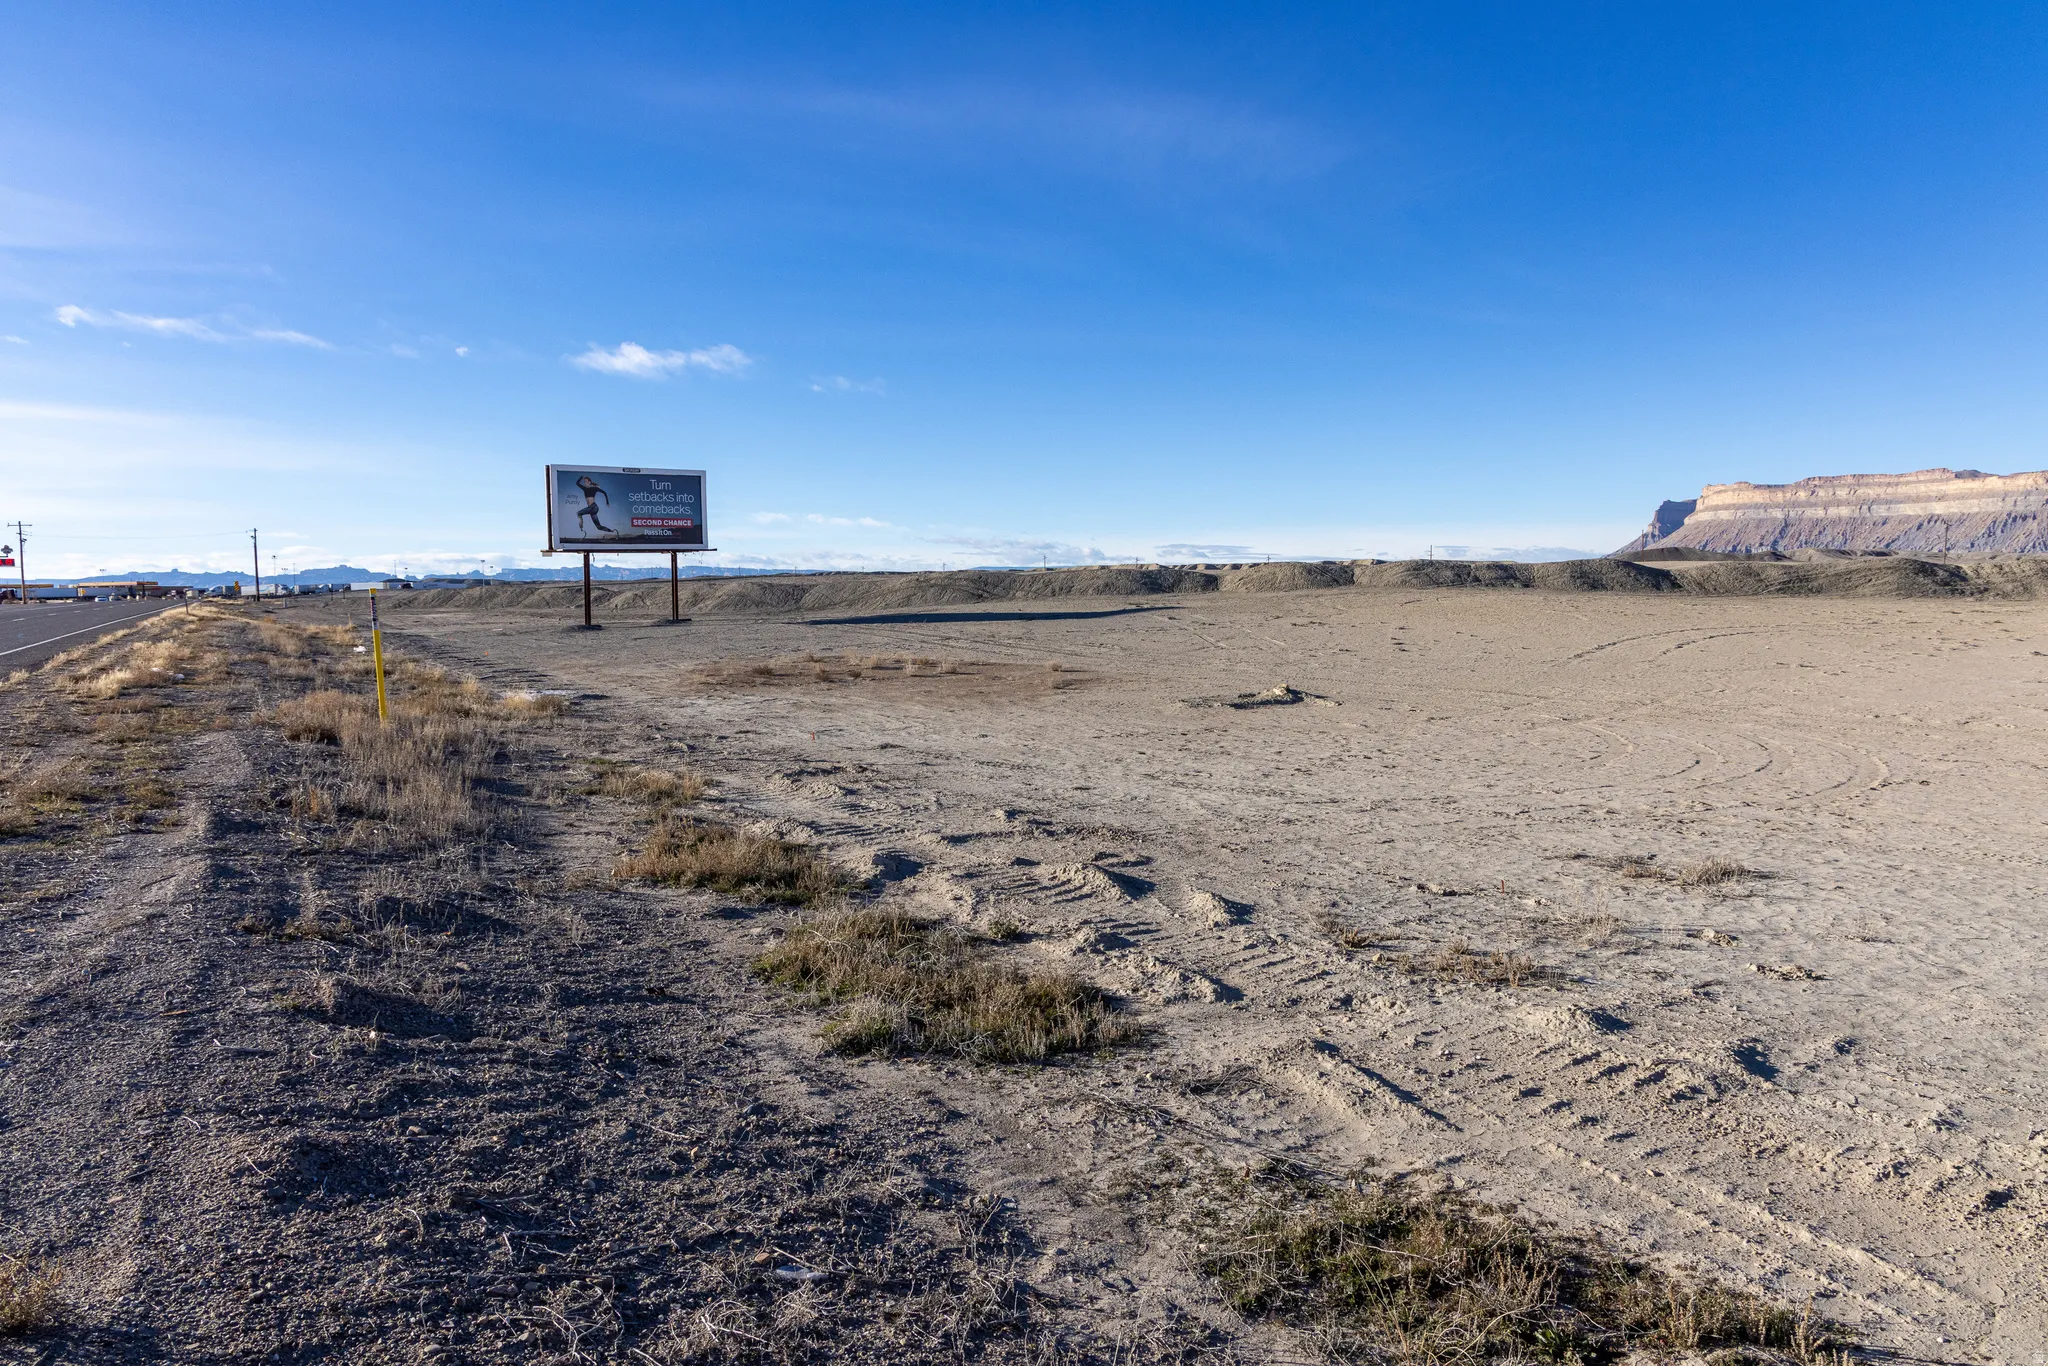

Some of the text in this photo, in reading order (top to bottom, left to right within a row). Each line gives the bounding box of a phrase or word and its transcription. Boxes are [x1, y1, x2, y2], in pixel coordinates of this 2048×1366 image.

[649, 479, 672, 490] Turn
[628, 491, 695, 503] setbacks into
[632, 503, 693, 515] comebacks.
[633, 518, 662, 526] SECOND
